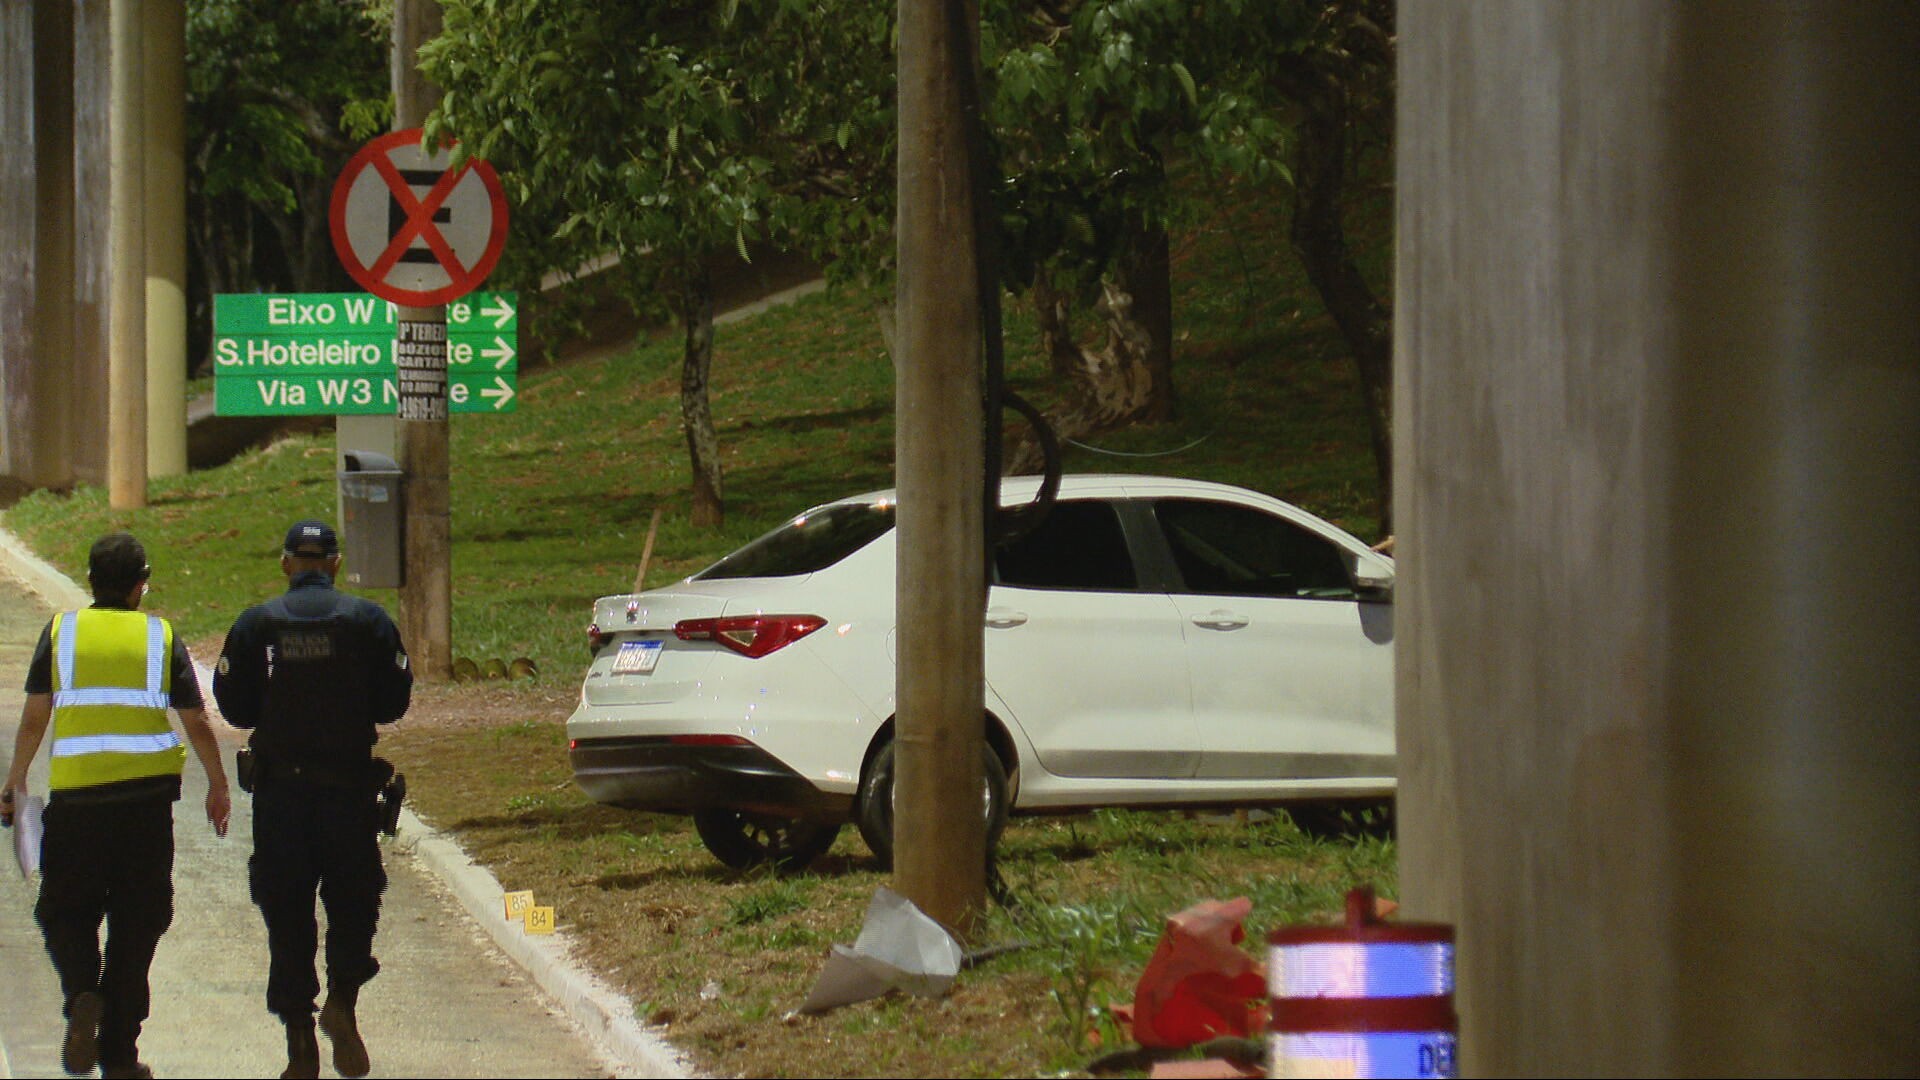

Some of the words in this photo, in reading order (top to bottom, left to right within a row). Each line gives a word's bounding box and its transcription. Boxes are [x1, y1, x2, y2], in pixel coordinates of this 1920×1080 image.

[268, 298, 336, 324] Eixo
[343, 298, 375, 324] W
[257, 380, 306, 405] Via
[512, 895, 527, 911] 85
[531, 911, 546, 926] 84
